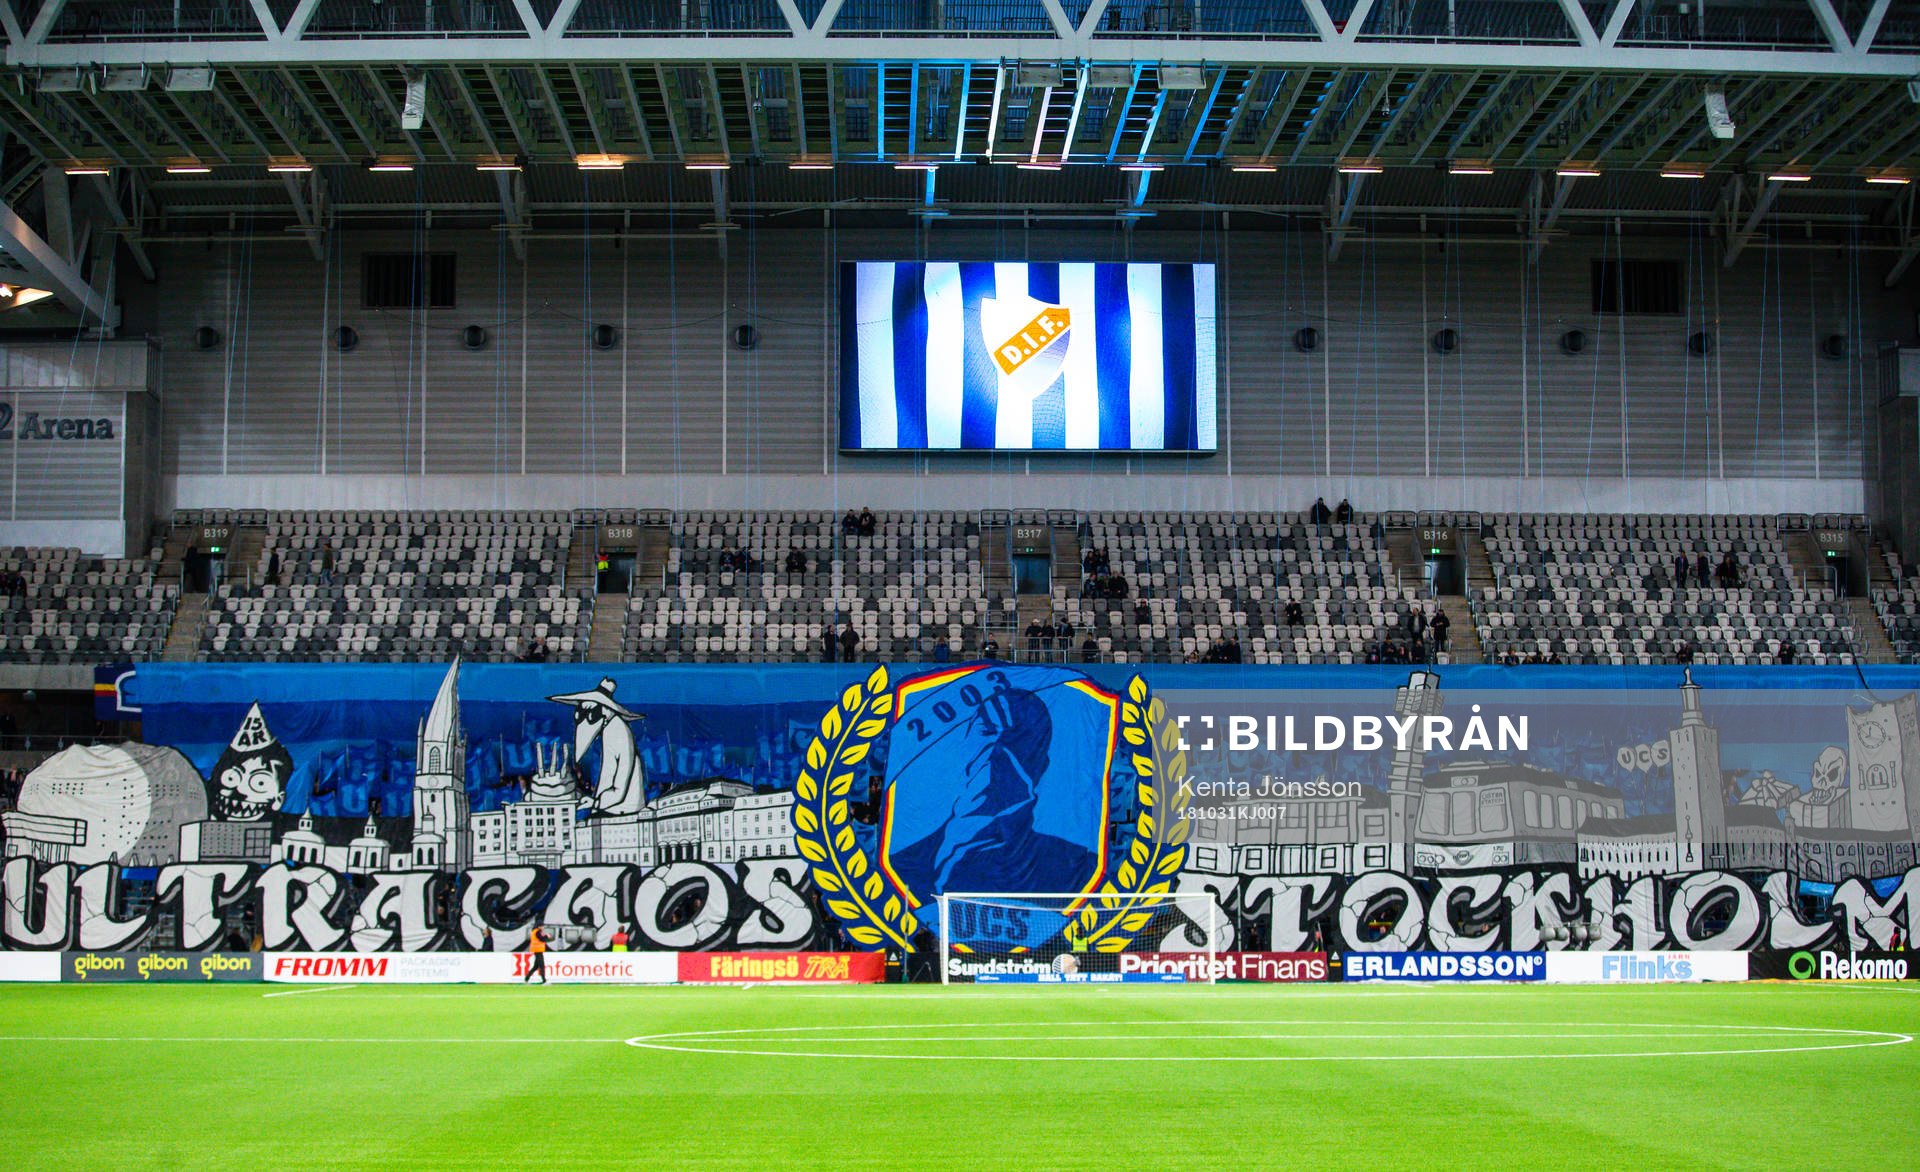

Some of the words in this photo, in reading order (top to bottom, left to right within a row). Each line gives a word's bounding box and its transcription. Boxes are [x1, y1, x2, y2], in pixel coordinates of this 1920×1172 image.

[1001, 315, 1064, 366] D.I.F.
[19, 412, 114, 440] Arena
[204, 528, 229, 538] B319
[608, 528, 633, 538] B318
[1017, 529, 1042, 539] B317
[1423, 530, 1448, 540] B316
[1820, 533, 1843, 543] B315
[907, 671, 1012, 742] 2003
[243, 717, 262, 731] 15
[1621, 748, 1668, 764] UCS
[1159, 868, 1920, 951] STOCKHOLM
[951, 903, 1028, 940] UCS
[74, 953, 125, 980] gibon
[137, 953, 188, 980] gibon
[200, 953, 252, 980] gibon
[274, 957, 389, 977] FROMM
[711, 955, 799, 979] Färingsö
[948, 958, 1051, 976] Sundström
[1120, 953, 1237, 979] Prioritet
[1241, 953, 1326, 979] Finans
[1346, 955, 1535, 977] ERLANDSSON
[1602, 955, 1693, 979] Flinks
[1820, 950, 1908, 980] Rekomo
